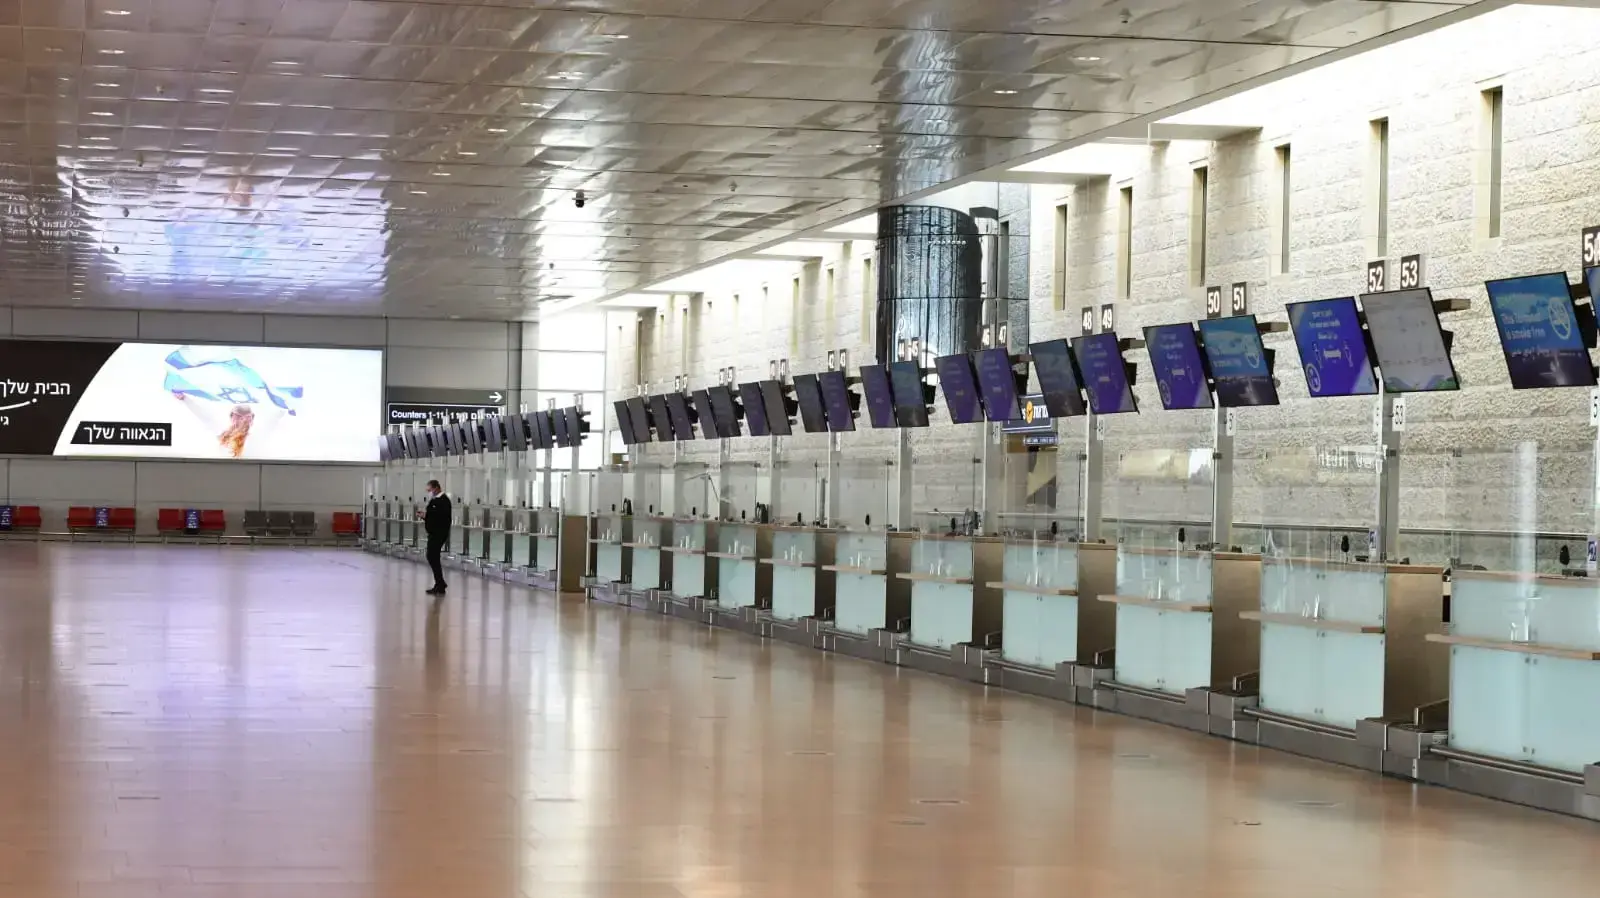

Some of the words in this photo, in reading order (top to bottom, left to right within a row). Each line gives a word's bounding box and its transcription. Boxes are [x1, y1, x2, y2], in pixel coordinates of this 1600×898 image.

[1369, 266, 1384, 292] 52
[1401, 260, 1418, 288] 53
[1207, 291, 1220, 314] 50
[1233, 286, 1245, 310] 51
[1082, 311, 1092, 330] 48
[1102, 308, 1113, 329] 49
[0, 378, 30, 398] שלך
[33, 382, 71, 396] הבית
[391, 410, 427, 420] Counters
[83, 423, 115, 443] שלך
[120, 427, 166, 441] הגאווה
